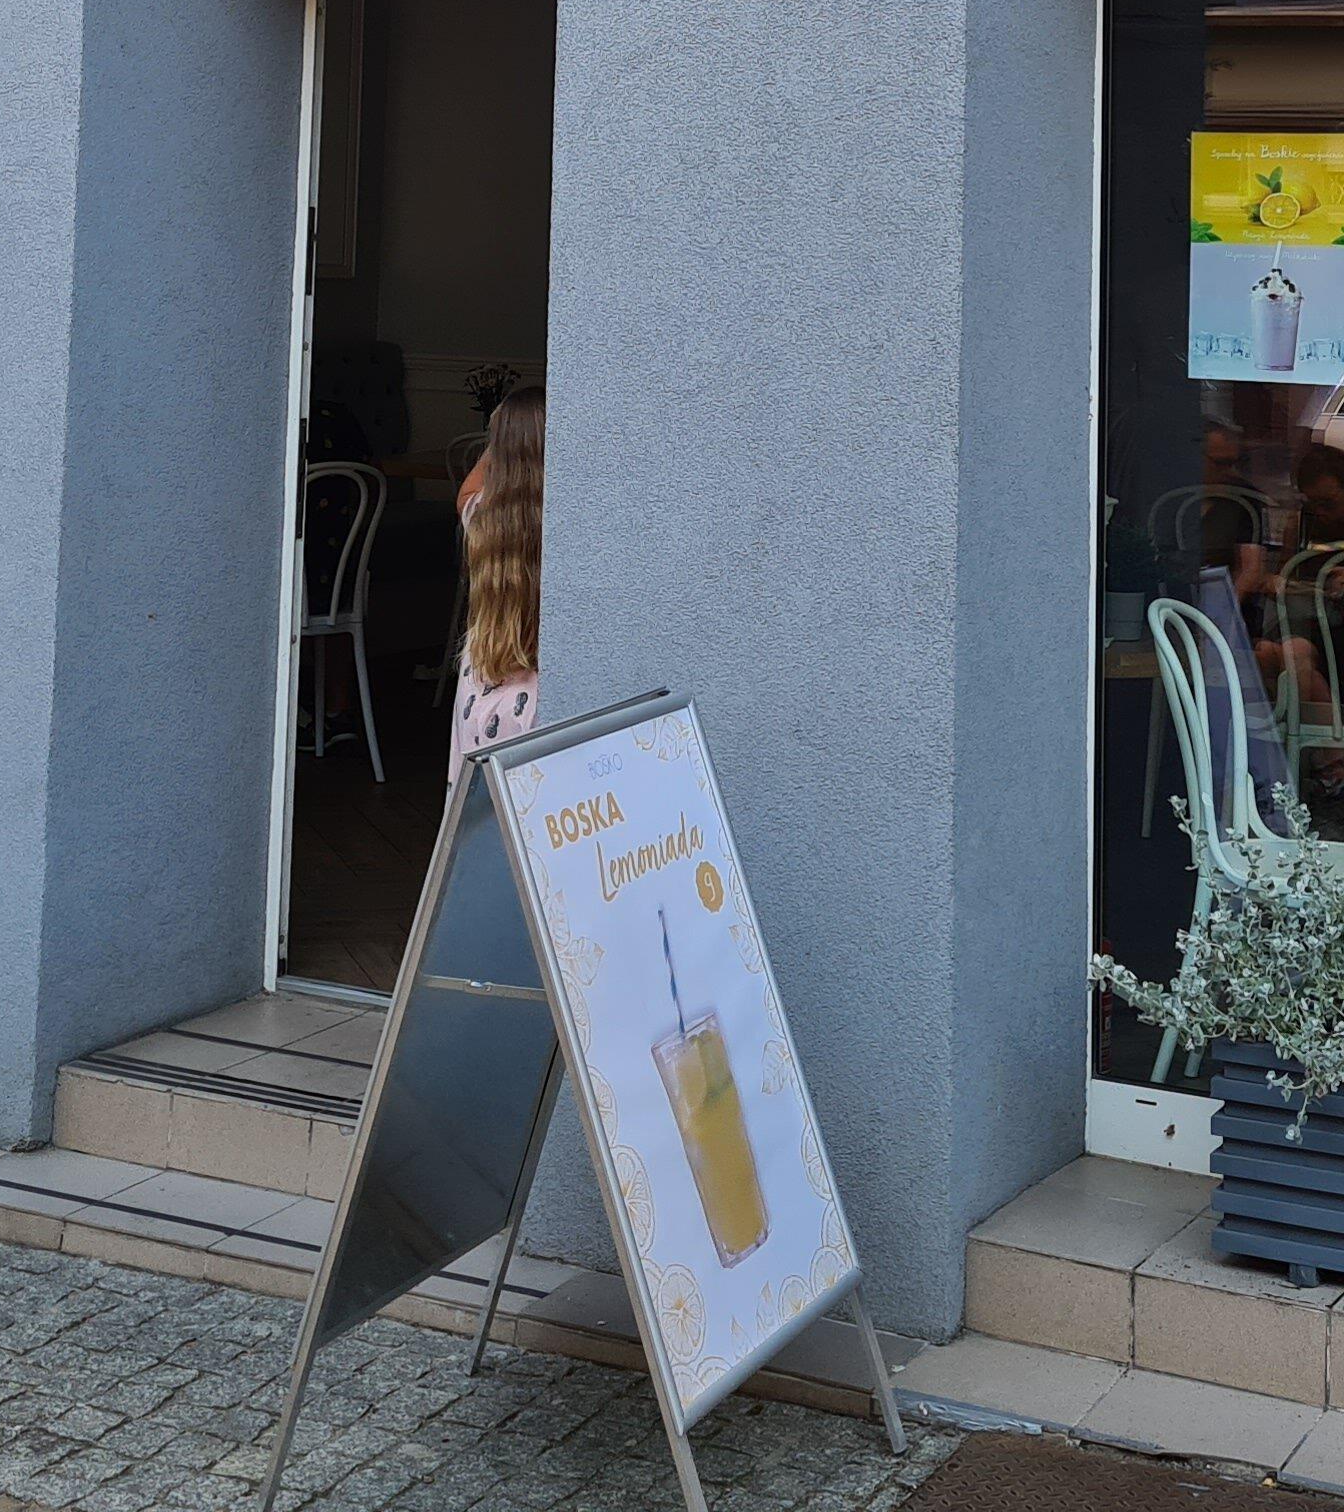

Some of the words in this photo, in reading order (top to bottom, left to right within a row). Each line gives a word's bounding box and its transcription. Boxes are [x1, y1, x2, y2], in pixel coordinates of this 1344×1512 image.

[544, 791, 626, 850] BOSKA
[596, 810, 705, 903] Lemoniada
[703, 870, 718, 903] 9
